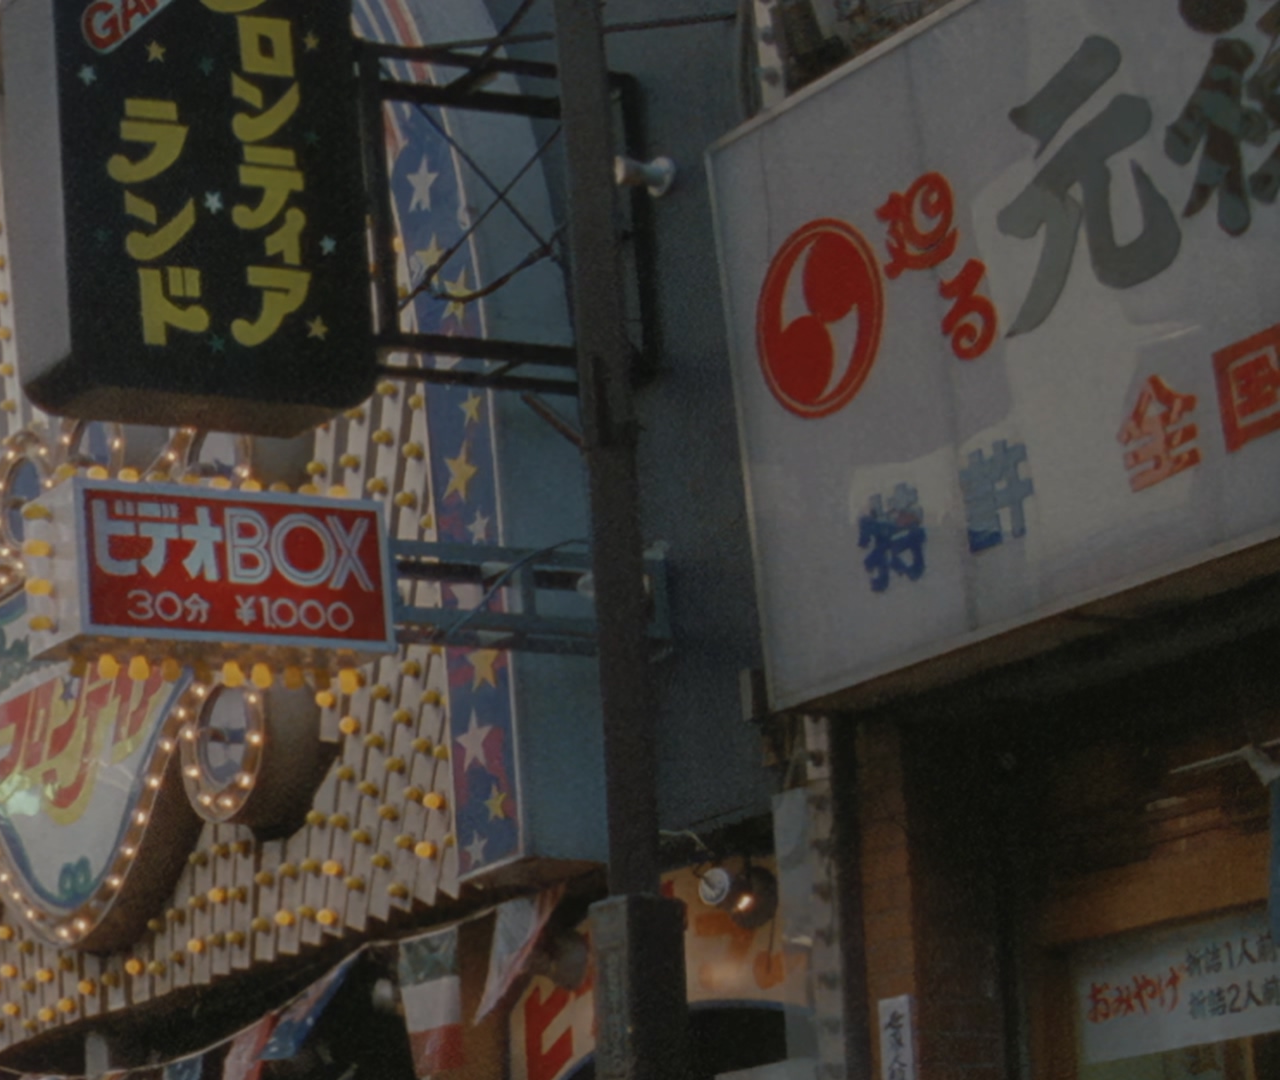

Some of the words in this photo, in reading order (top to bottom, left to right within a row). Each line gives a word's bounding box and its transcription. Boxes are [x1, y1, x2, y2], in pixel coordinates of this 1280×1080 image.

[107, 98, 210, 346] ランド
[92, 498, 375, 592] ビデオBOX
[127, 589, 211, 624] 30分
